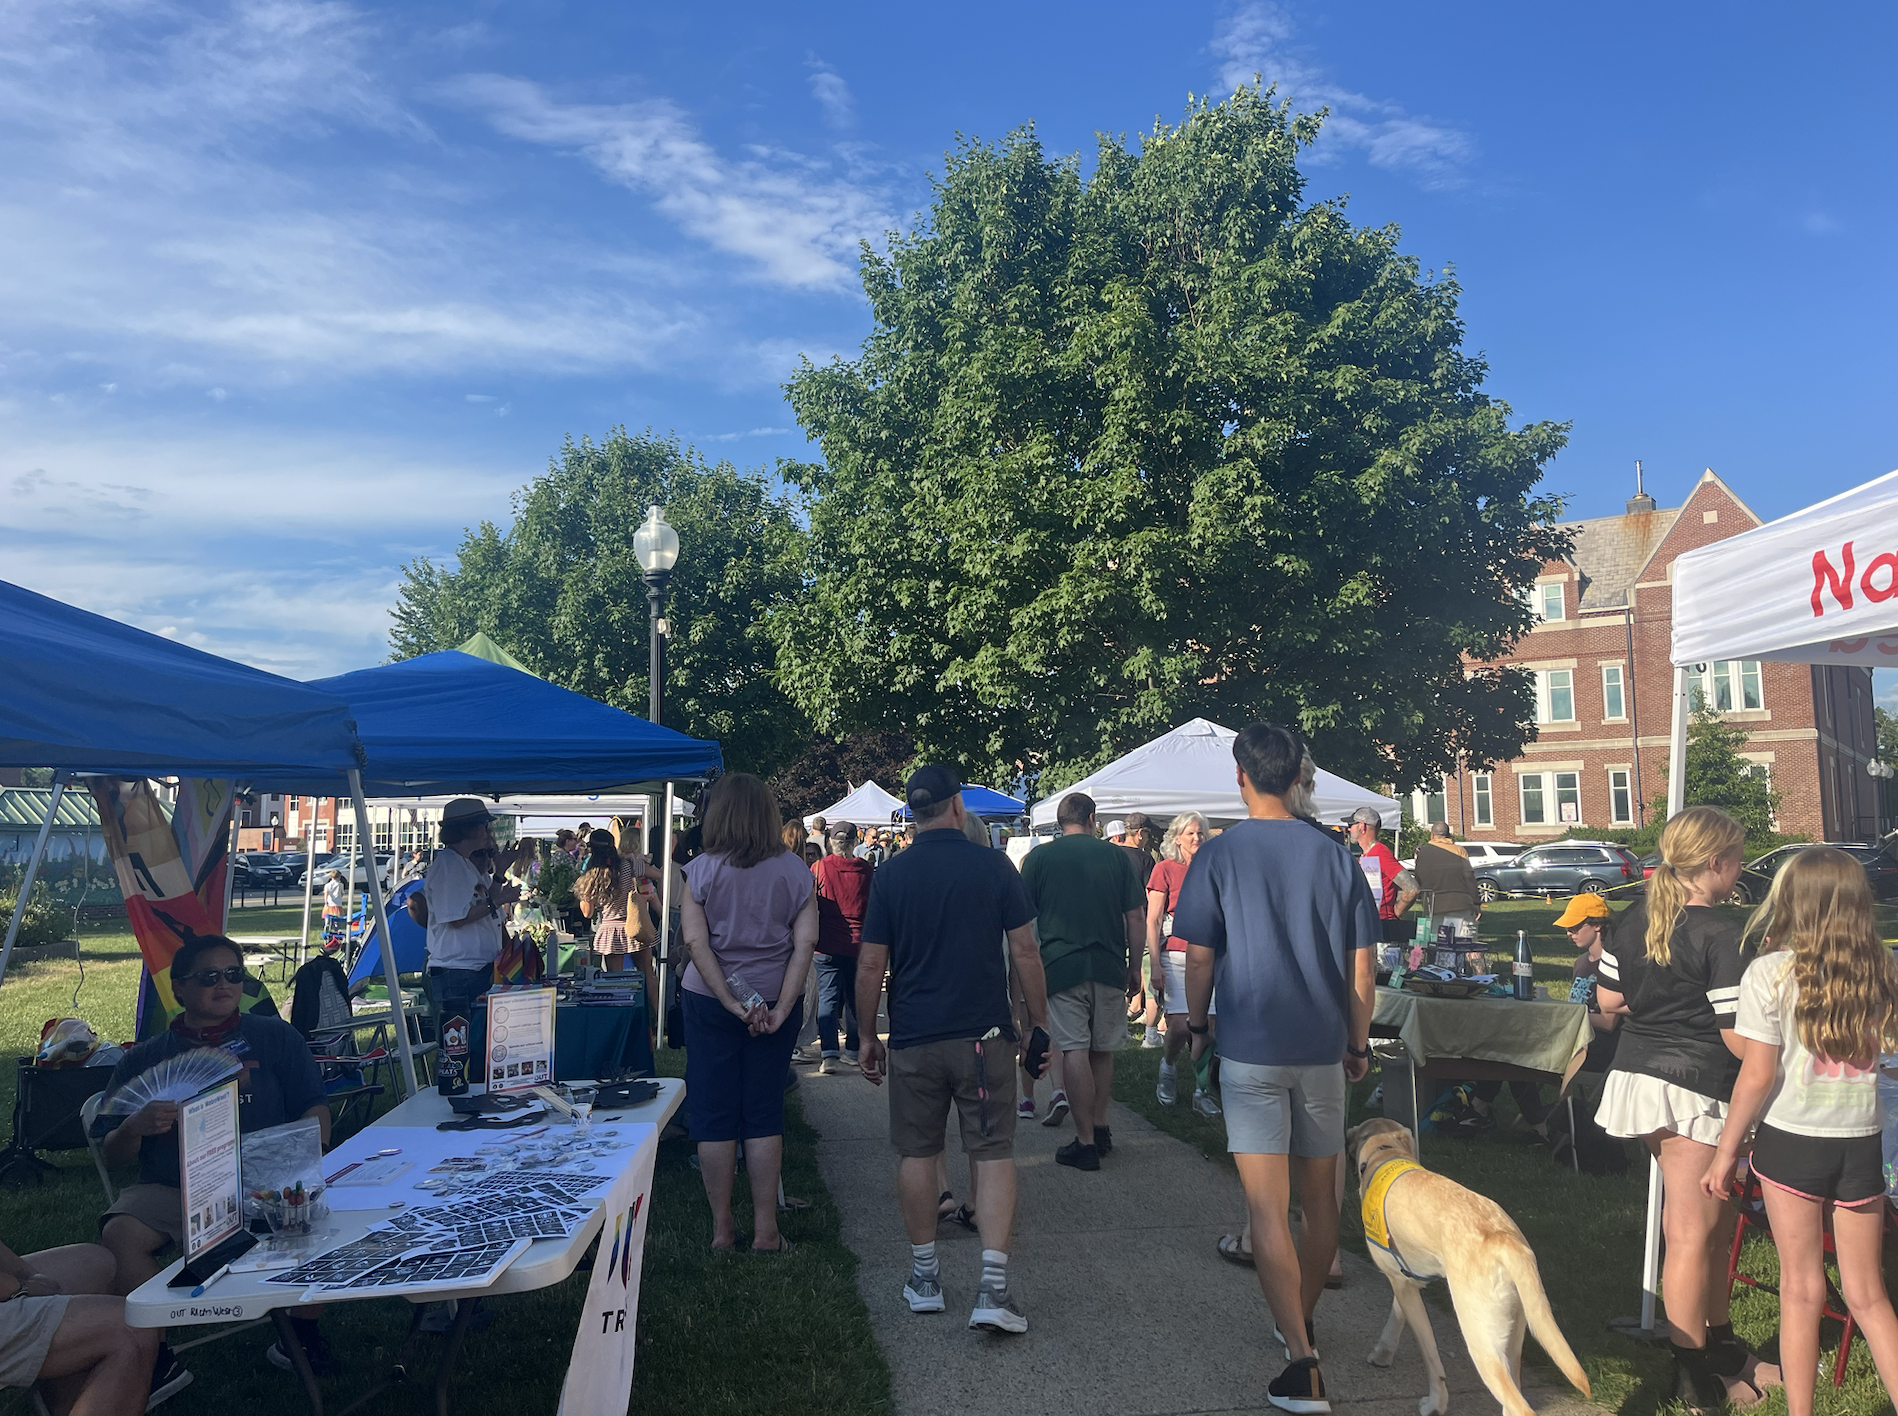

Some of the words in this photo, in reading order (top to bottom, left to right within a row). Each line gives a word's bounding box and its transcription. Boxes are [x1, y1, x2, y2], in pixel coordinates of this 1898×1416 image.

[1811, 541, 1898, 618] Na
[534, 1073, 548, 1081] OUT
[188, 1104, 200, 1115] What
[186, 1157, 200, 1168] About
[206, 1146, 217, 1157] FREE
[170, 1308, 187, 1319] OUT
